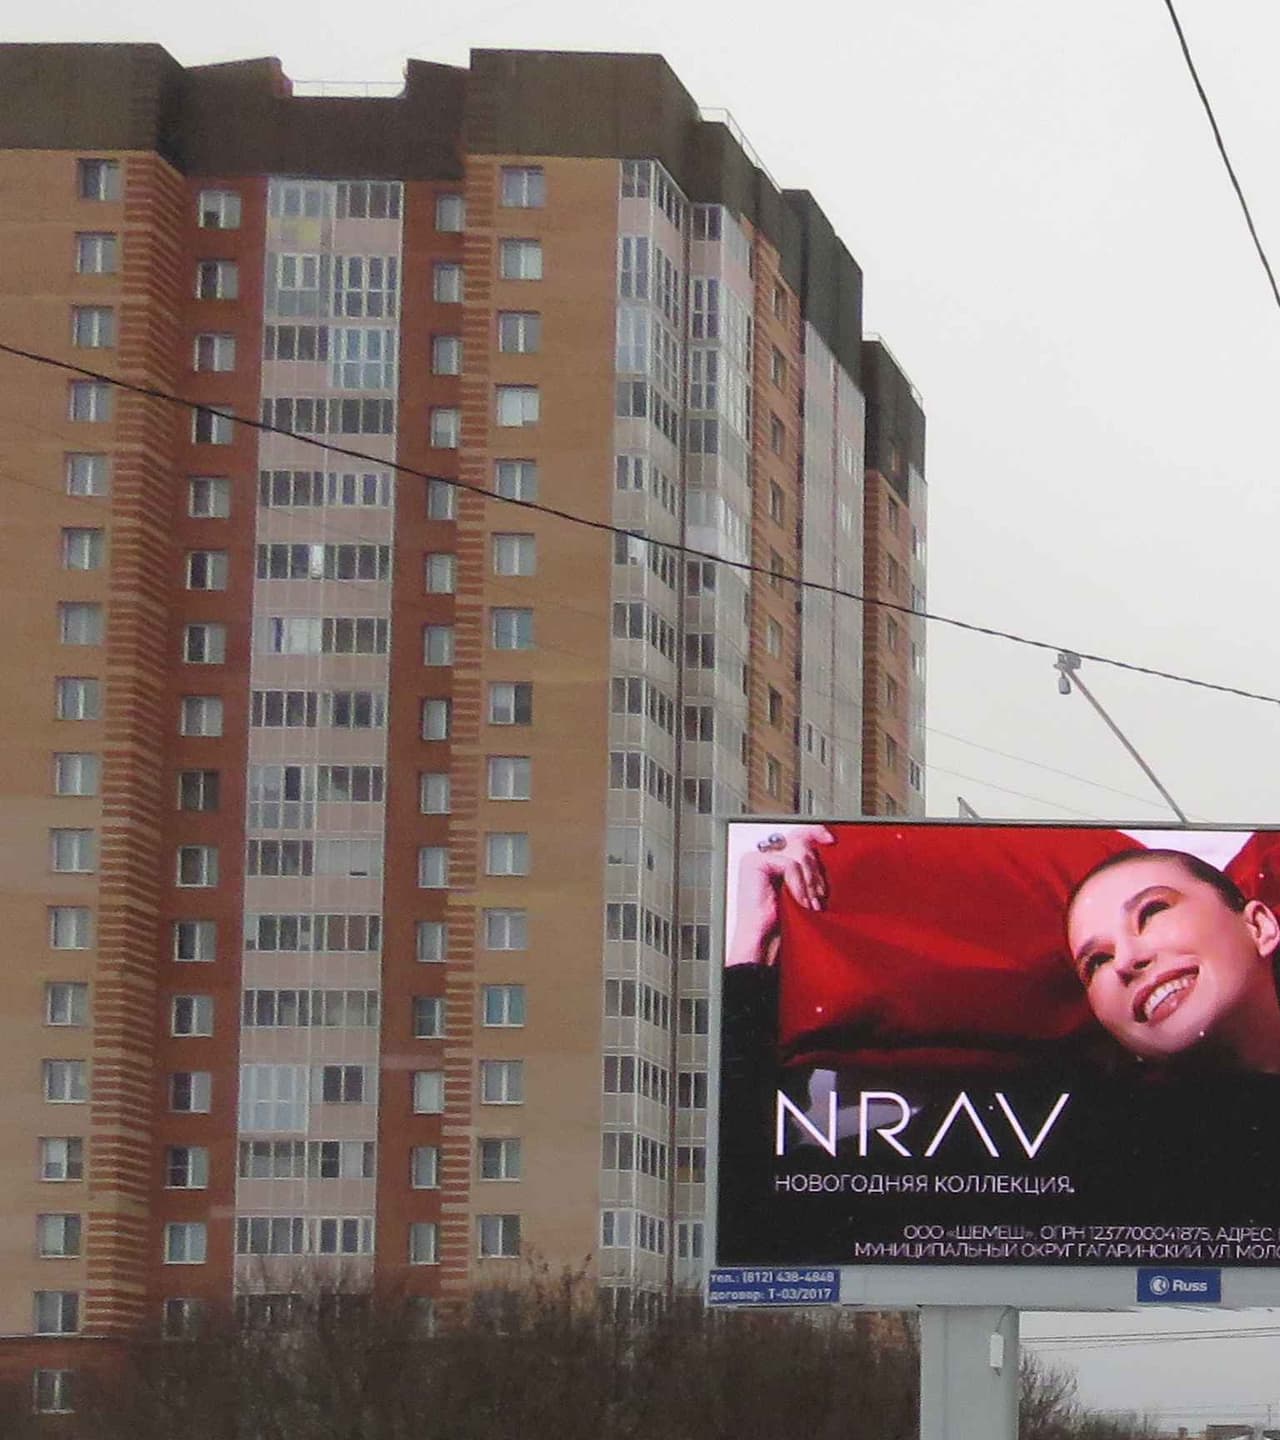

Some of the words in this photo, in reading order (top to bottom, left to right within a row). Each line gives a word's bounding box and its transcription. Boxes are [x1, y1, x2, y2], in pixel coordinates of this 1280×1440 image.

[776, 1089, 1071, 1159] NRAV
[775, 1174, 929, 1194] НОВОГОДНЯЯ
[904, 1225, 945, 1239] ООО
[1040, 1225, 1085, 1240] ОГРН
[854, 1242, 1018, 1259] МУНИЦИПАЛЬНЫЙ
[1021, 1242, 1075, 1258] ОКРУГ
[742, 1271, 773, 1283] (812)
[1172, 1279, 1208, 1292] Russ
